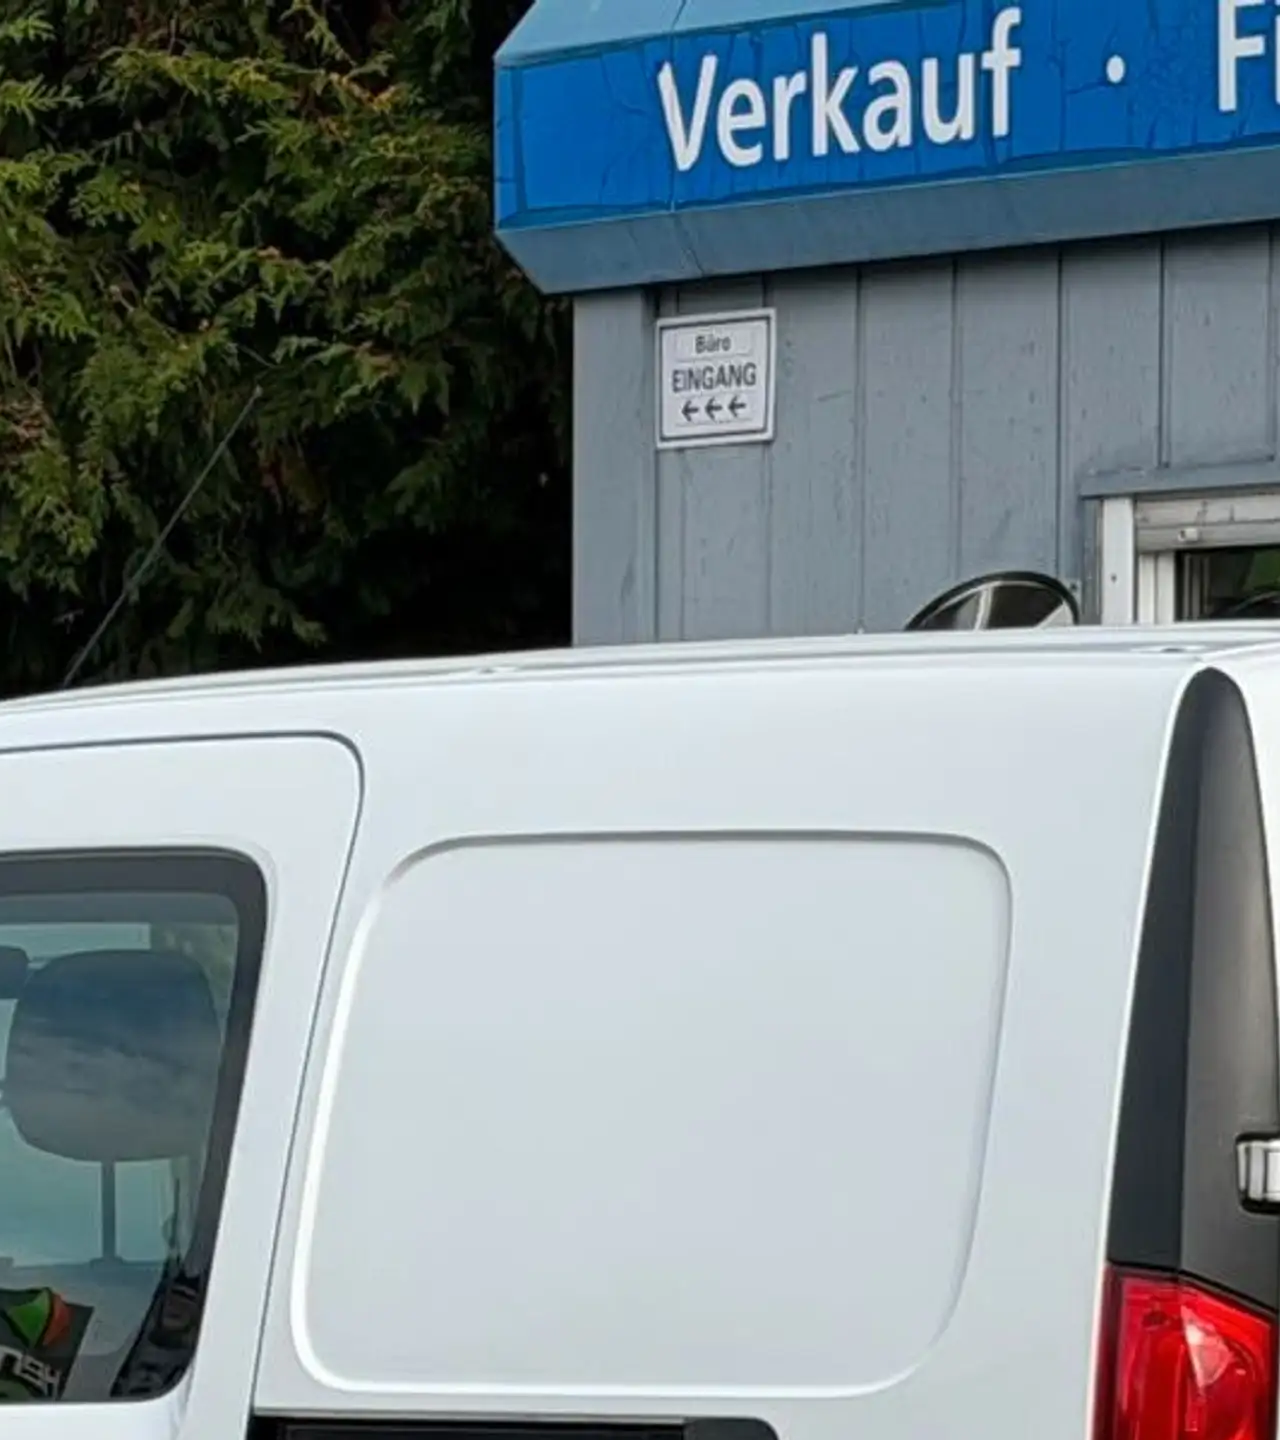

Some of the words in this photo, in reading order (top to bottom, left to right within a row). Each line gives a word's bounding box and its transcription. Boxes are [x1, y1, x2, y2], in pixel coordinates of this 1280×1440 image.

[657, 6, 1021, 172] Verkauf
[695, 333, 732, 355] Büro
[672, 361, 757, 394] EINGANG
